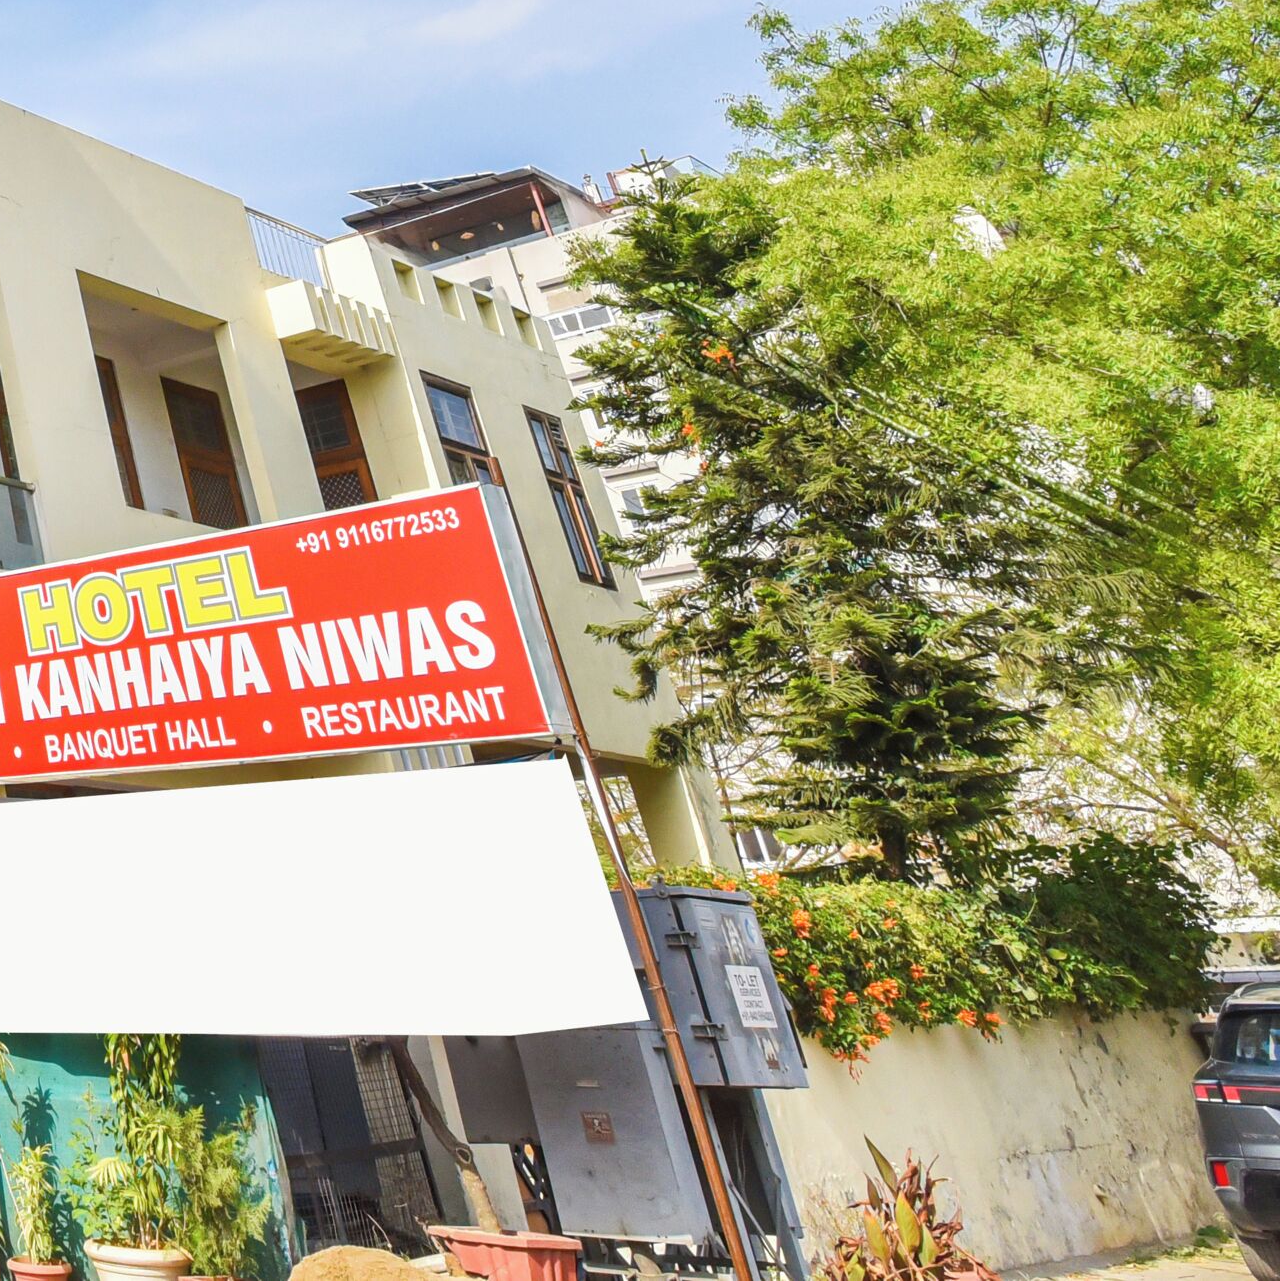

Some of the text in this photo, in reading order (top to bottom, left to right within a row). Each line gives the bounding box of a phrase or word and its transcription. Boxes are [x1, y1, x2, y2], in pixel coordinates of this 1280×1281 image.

[295, 506, 461, 554] +91 9116772533
[17, 545, 294, 657] HOTEL
[14, 630, 272, 723] KANHAIYA
[278, 598, 497, 691] NIWAS
[44, 722, 165, 765] BANQUET
[165, 715, 237, 750] HALL
[301, 685, 506, 740] RESTAURANT
